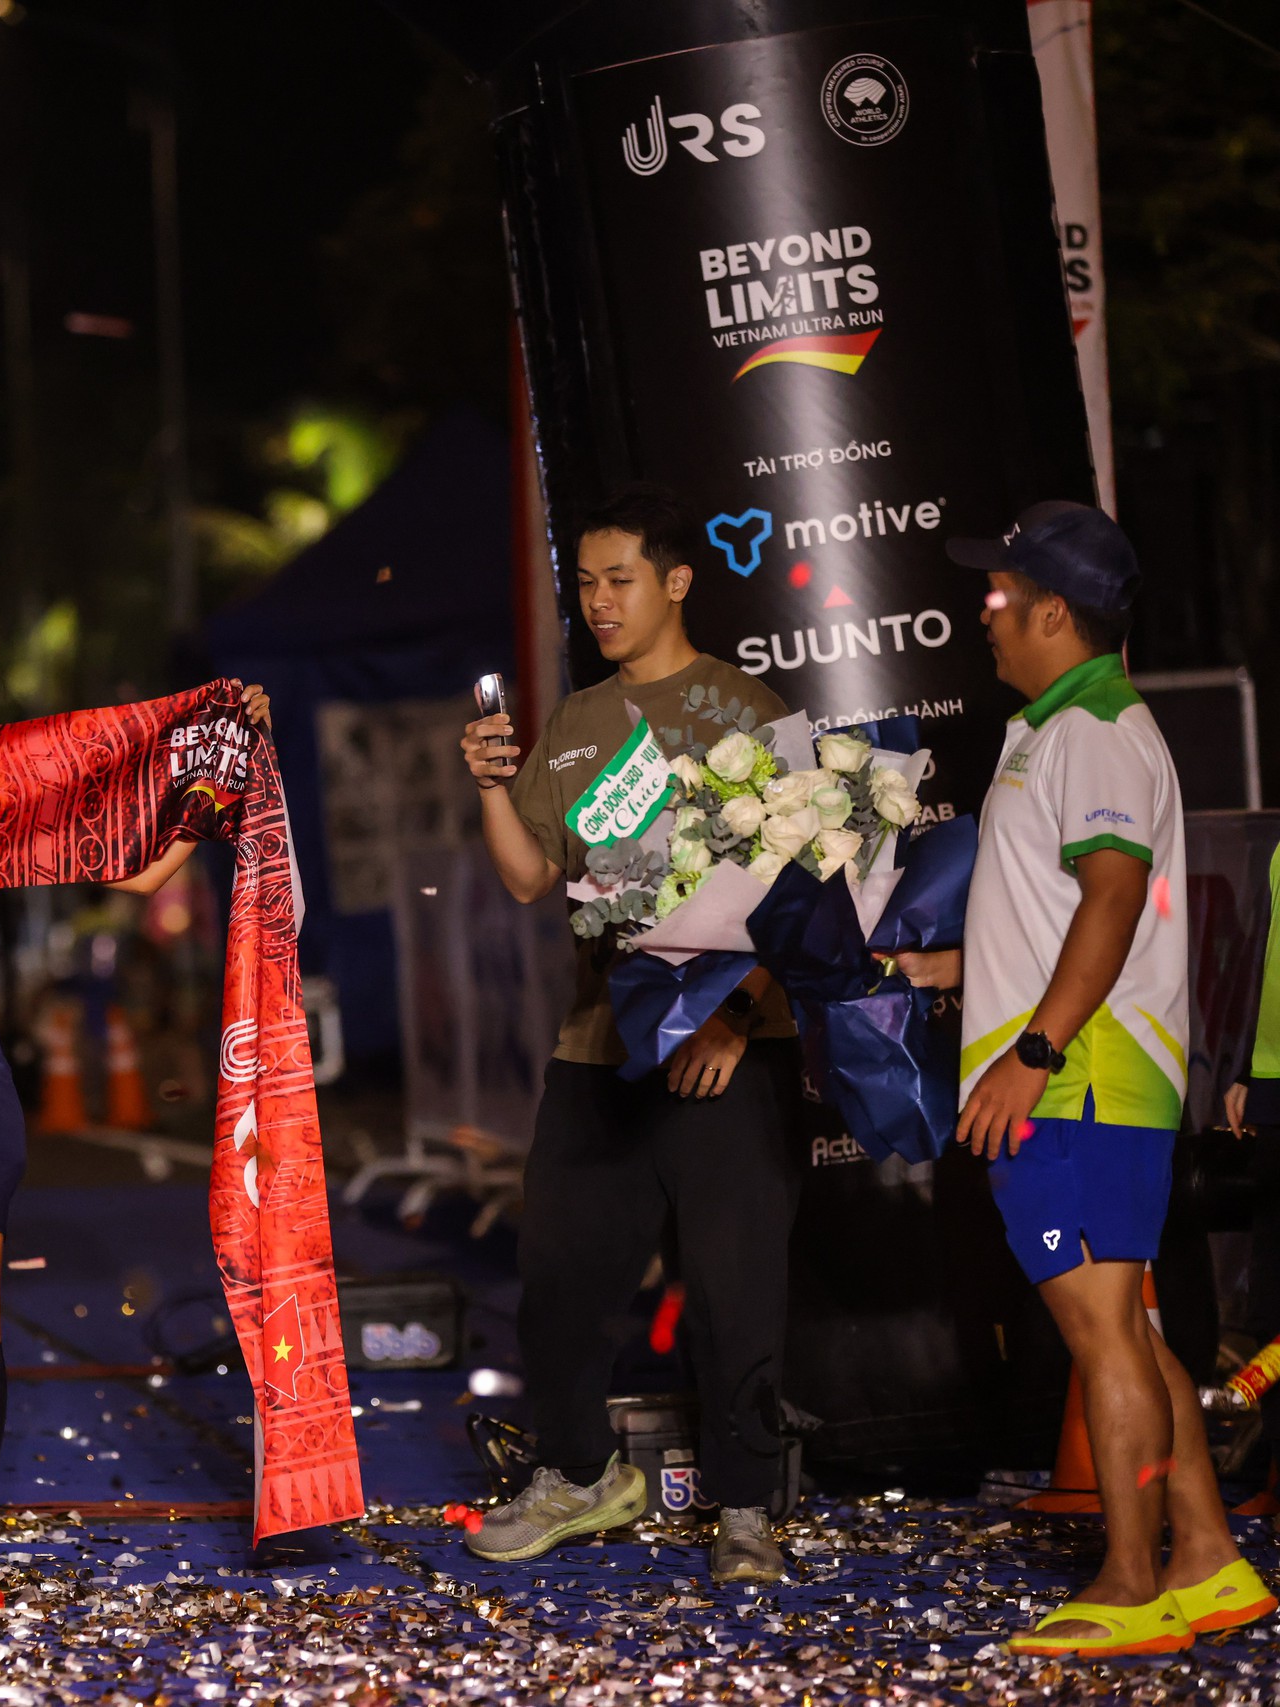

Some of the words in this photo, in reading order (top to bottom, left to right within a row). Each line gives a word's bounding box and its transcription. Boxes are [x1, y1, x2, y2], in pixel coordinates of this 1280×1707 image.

[826, 60, 856, 91] MEASURED
[856, 57, 885, 69] COURSE
[850, 113, 888, 124] ATHLETICS
[855, 107, 881, 116] WORLD
[622, 95, 766, 176] URS
[699, 226, 872, 281] BEYOND
[705, 264, 879, 329] LIMITS
[712, 324, 788, 348] VIETNAM
[791, 315, 845, 335] ULTRA
[849, 308, 884, 326] RUN
[743, 456, 776, 478] TÀI
[780, 448, 824, 470] TRỢ
[828, 440, 892, 465] ĐỒNG
[784, 500, 942, 549] motive
[737, 609, 951, 676] SUUNTO
[904, 698, 964, 720] HÀNH
[172, 768, 213, 789] VIETNAM
[913, 803, 956, 826] AB
